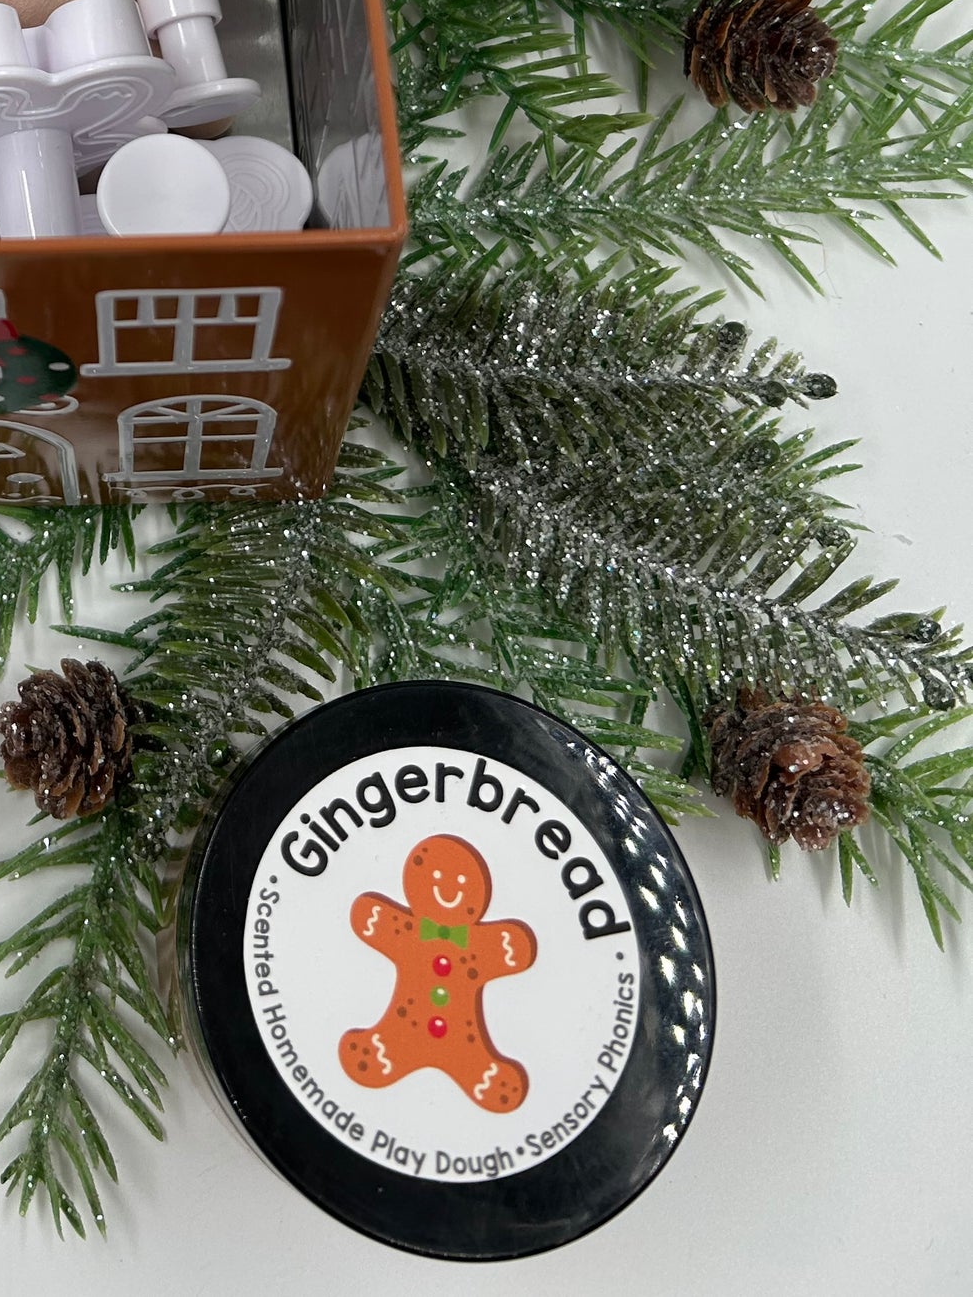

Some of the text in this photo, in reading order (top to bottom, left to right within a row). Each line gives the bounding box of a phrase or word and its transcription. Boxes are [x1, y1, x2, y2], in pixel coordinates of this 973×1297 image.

[280, 759, 631, 940] Gingerbread
[253, 887, 514, 1178] Scented Homemade Play Dough
[525, 972, 635, 1156] Sensory Phonics
